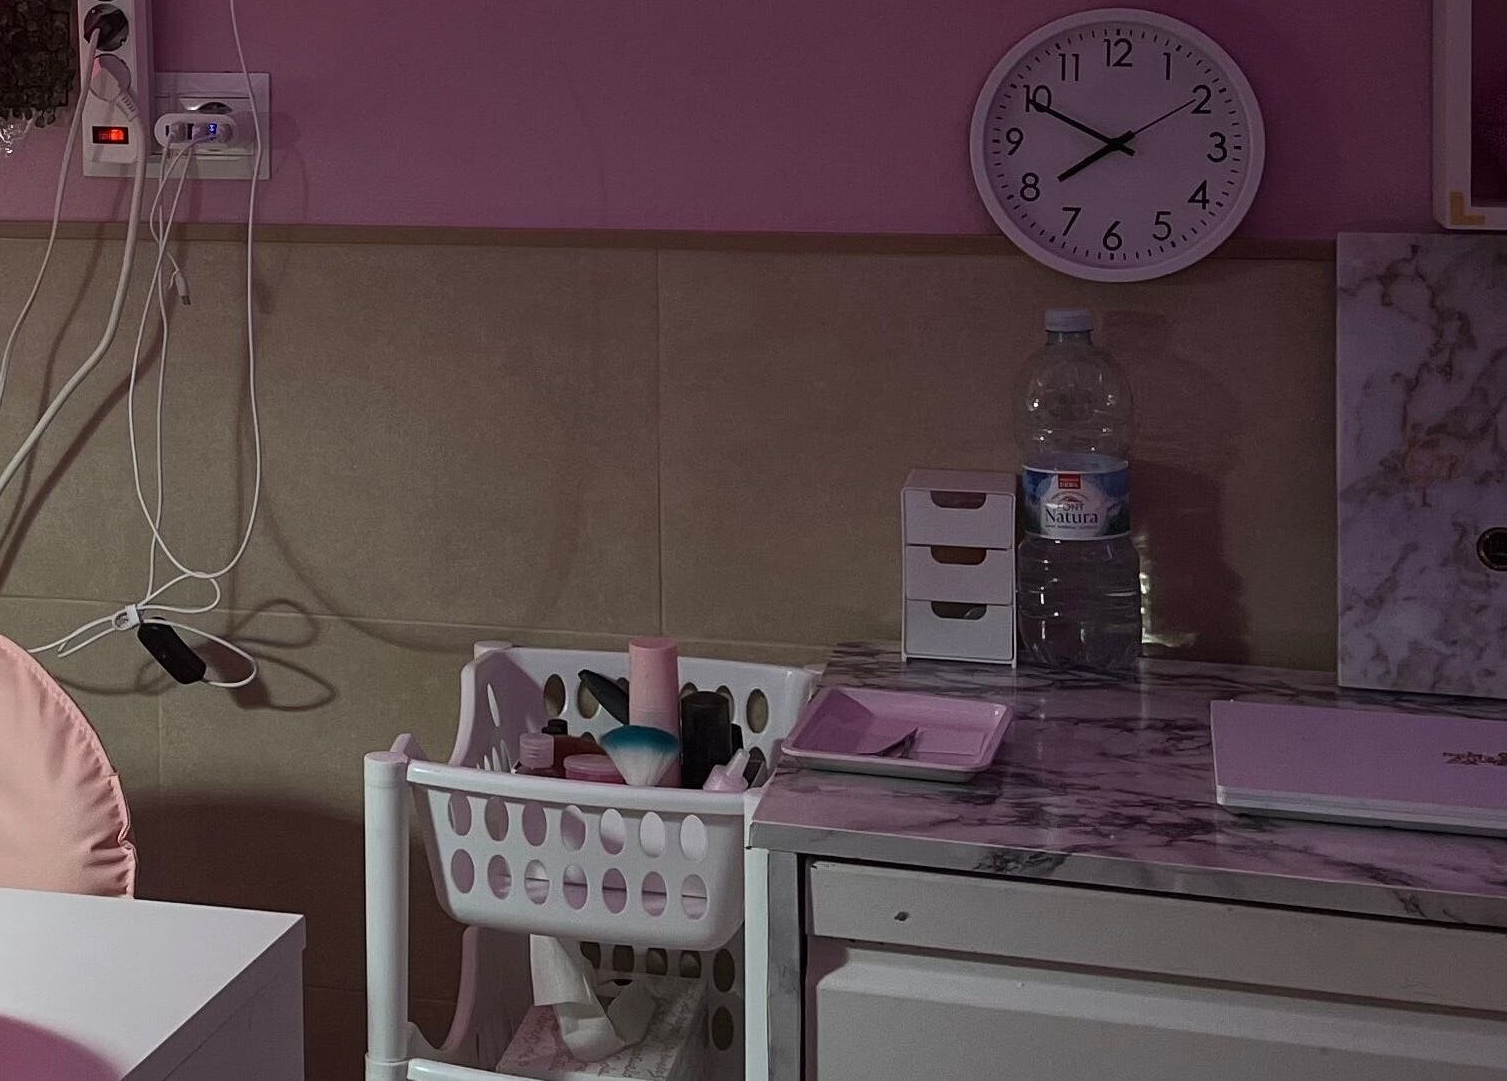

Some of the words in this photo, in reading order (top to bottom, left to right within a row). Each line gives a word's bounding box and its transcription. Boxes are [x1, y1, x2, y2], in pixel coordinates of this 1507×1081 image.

[1059, 53, 1080, 81] 11
[1103, 37, 1133, 68] 12
[1163, 52, 1171, 81] 1
[1024, 84, 1053, 113] 10
[1191, 84, 1212, 115] 2
[1005, 127, 1024, 156] 9
[1206, 131, 1228, 162] 3
[1019, 172, 1041, 202] 8
[1187, 179, 1210, 210] 4
[1062, 206, 1082, 237] 7
[1102, 220, 1123, 251] 6
[1152, 210, 1172, 241] 5
[1045, 507, 1099, 524] Natura
